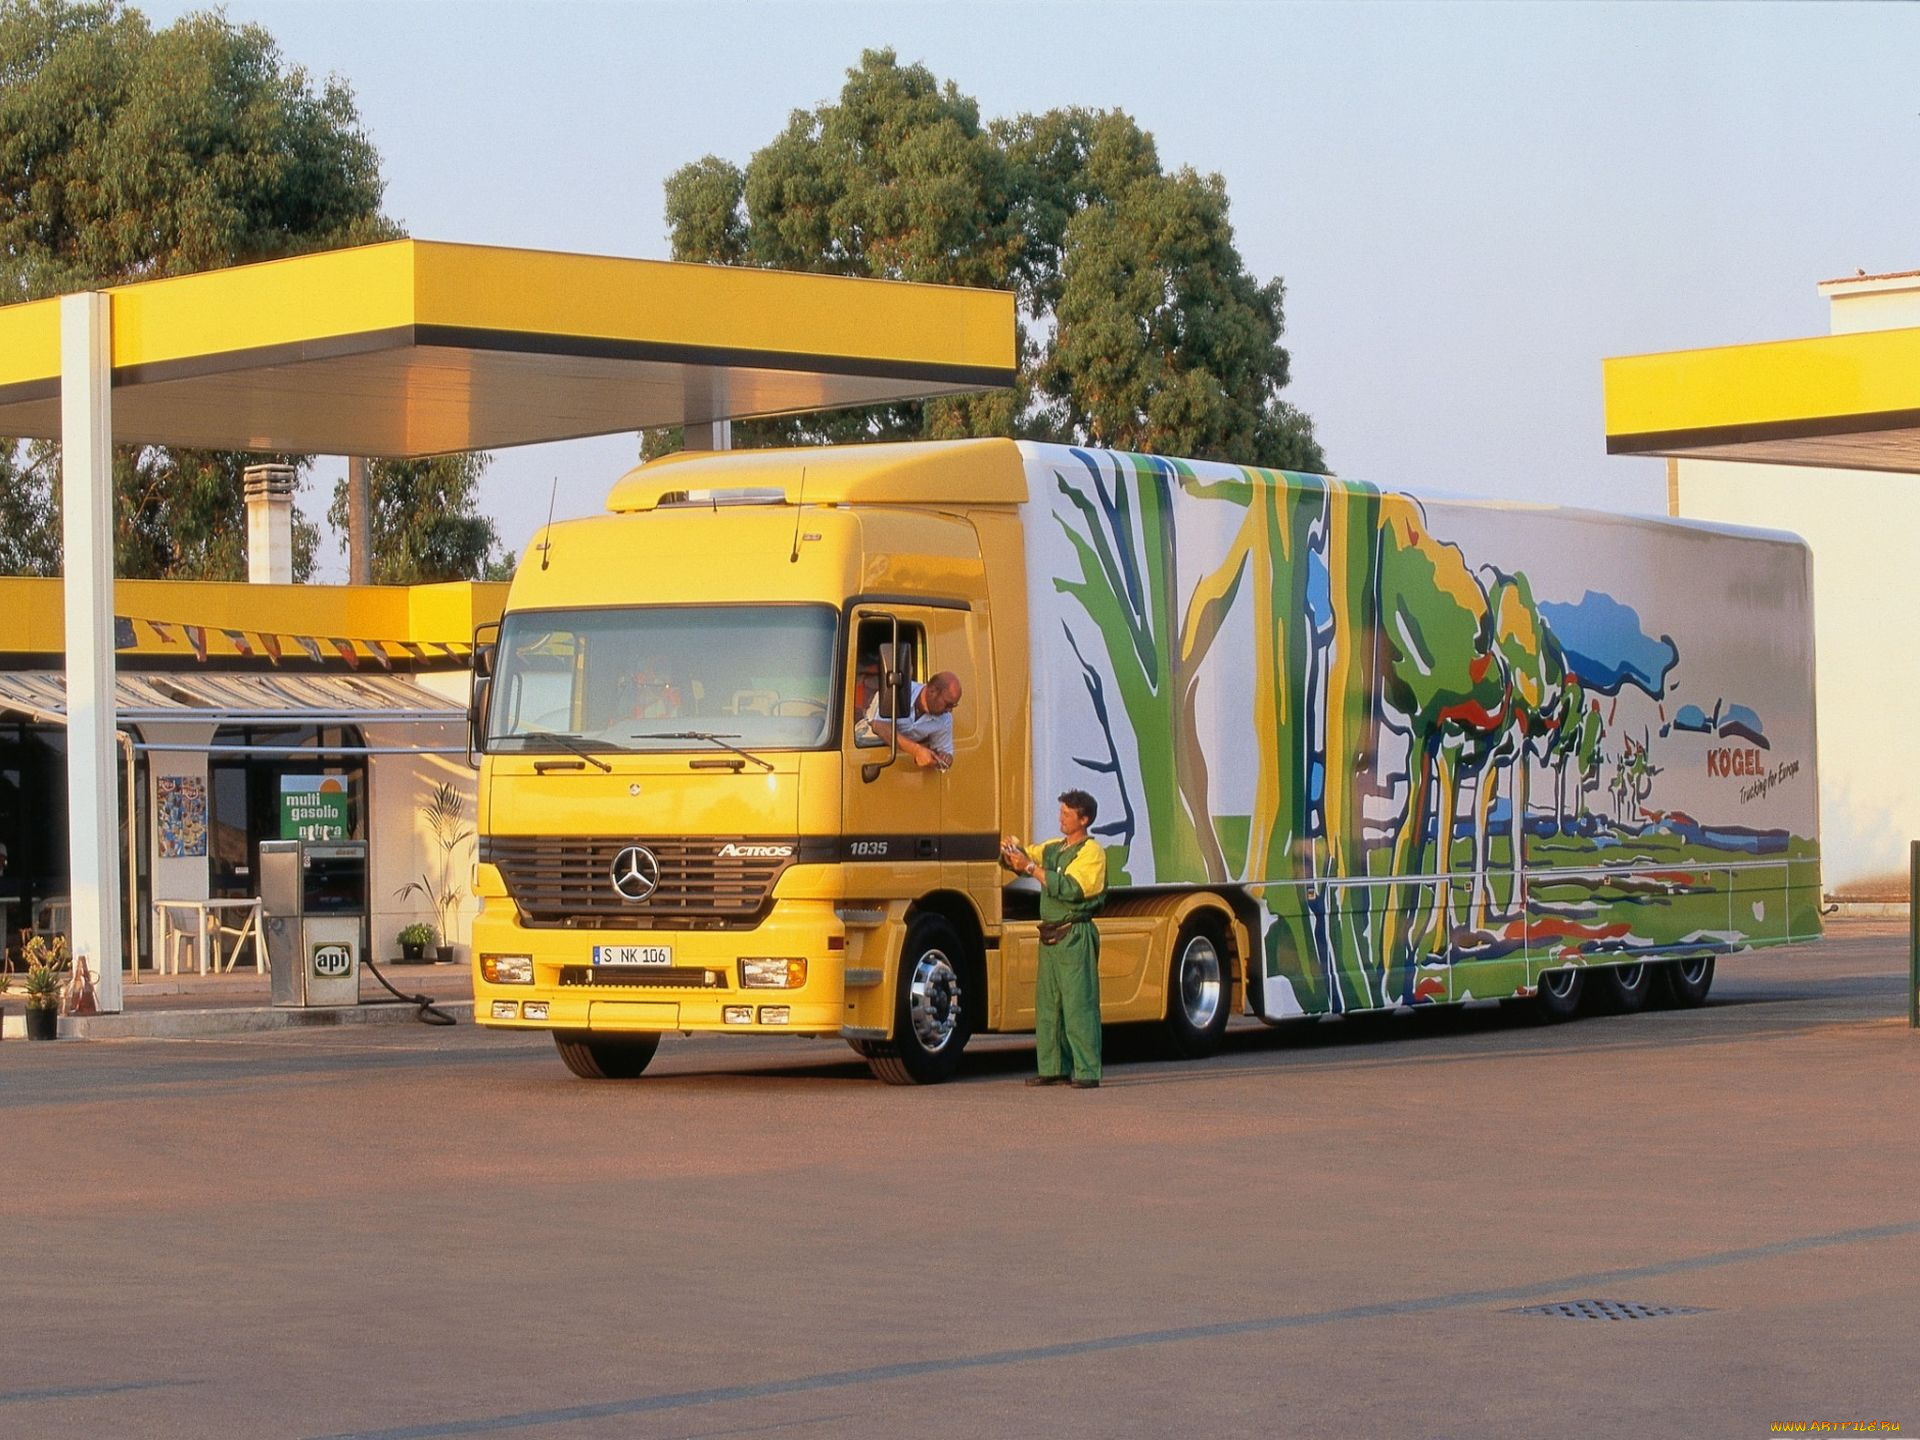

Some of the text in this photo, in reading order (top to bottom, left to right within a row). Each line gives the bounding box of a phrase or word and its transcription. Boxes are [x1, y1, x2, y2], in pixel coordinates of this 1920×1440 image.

[1740, 760, 1799, 805] Trucking for Europe
[286, 793, 320, 806] multi
[291, 805, 338, 821] gasolio
[850, 842, 888, 855] 1835
[317, 948, 346, 972] api
[604, 948, 666, 963] S NK 106
